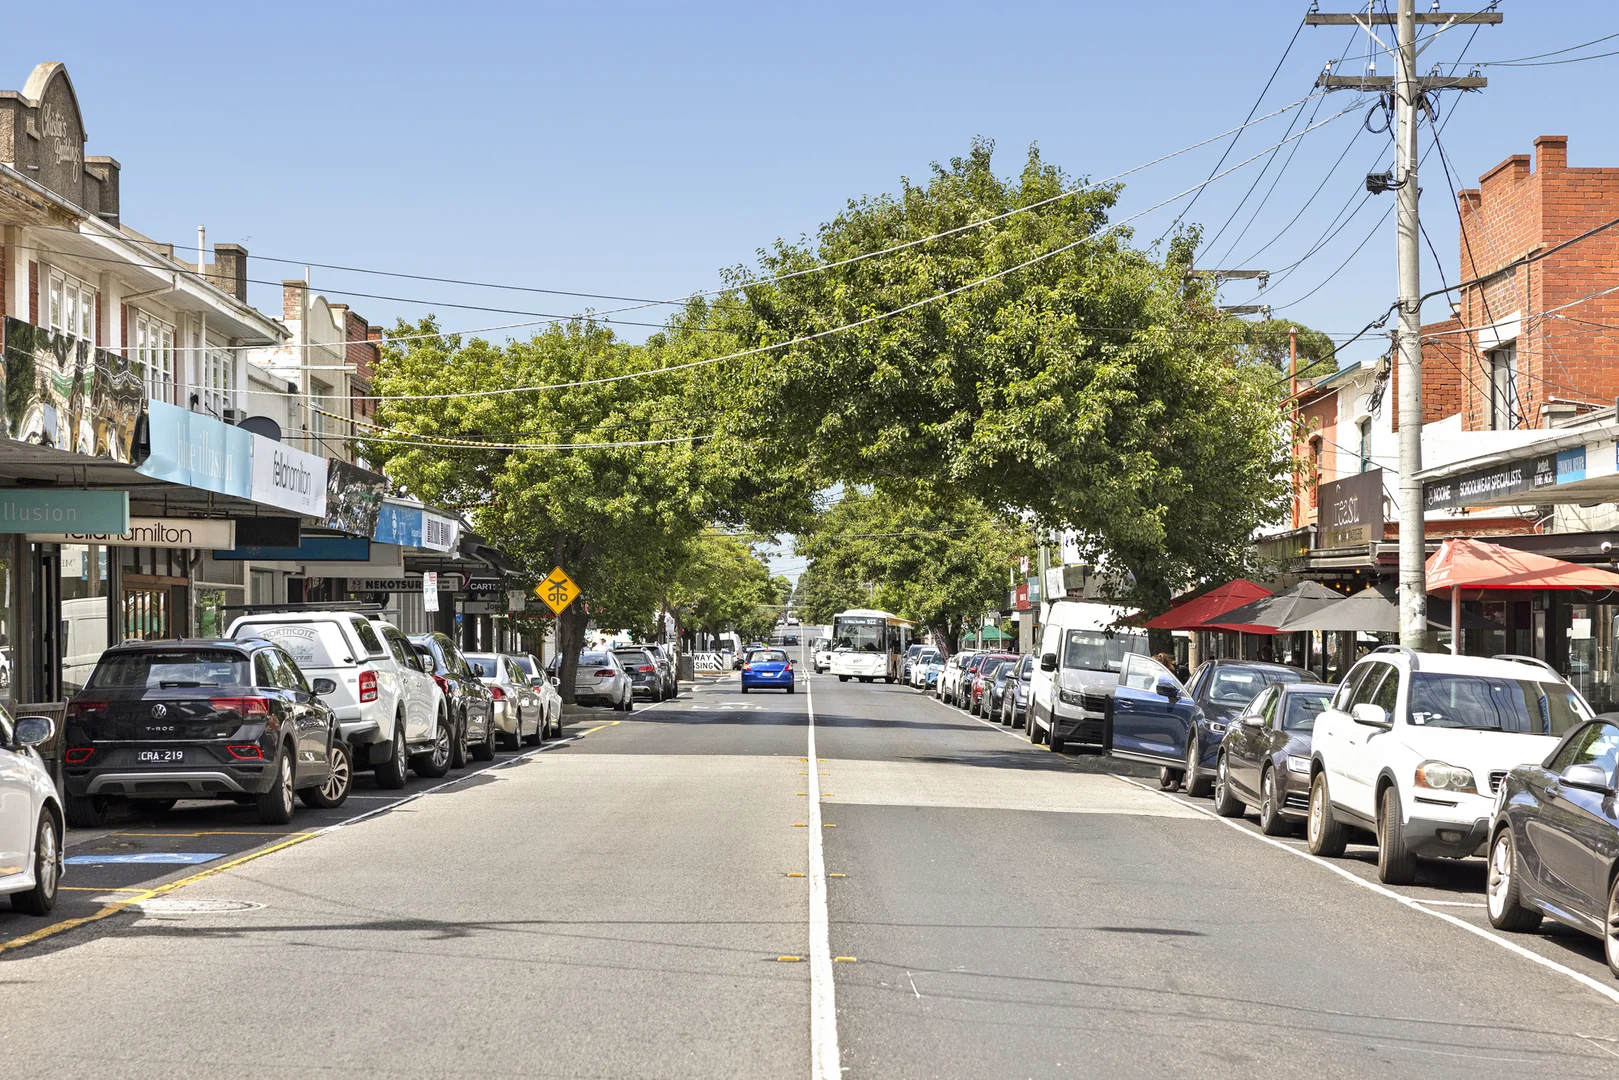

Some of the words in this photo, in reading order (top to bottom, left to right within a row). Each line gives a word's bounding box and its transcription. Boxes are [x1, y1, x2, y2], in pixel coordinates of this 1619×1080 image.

[1491, 469, 1522, 490] SPECIALISTS
[1534, 474, 1543, 486] THE
[1543, 472, 1554, 484] AGE
[4, 502, 77, 522] llusion
[365, 580, 422, 590] NEKOTSUR
[263, 627, 315, 639] NORTHCOTE
